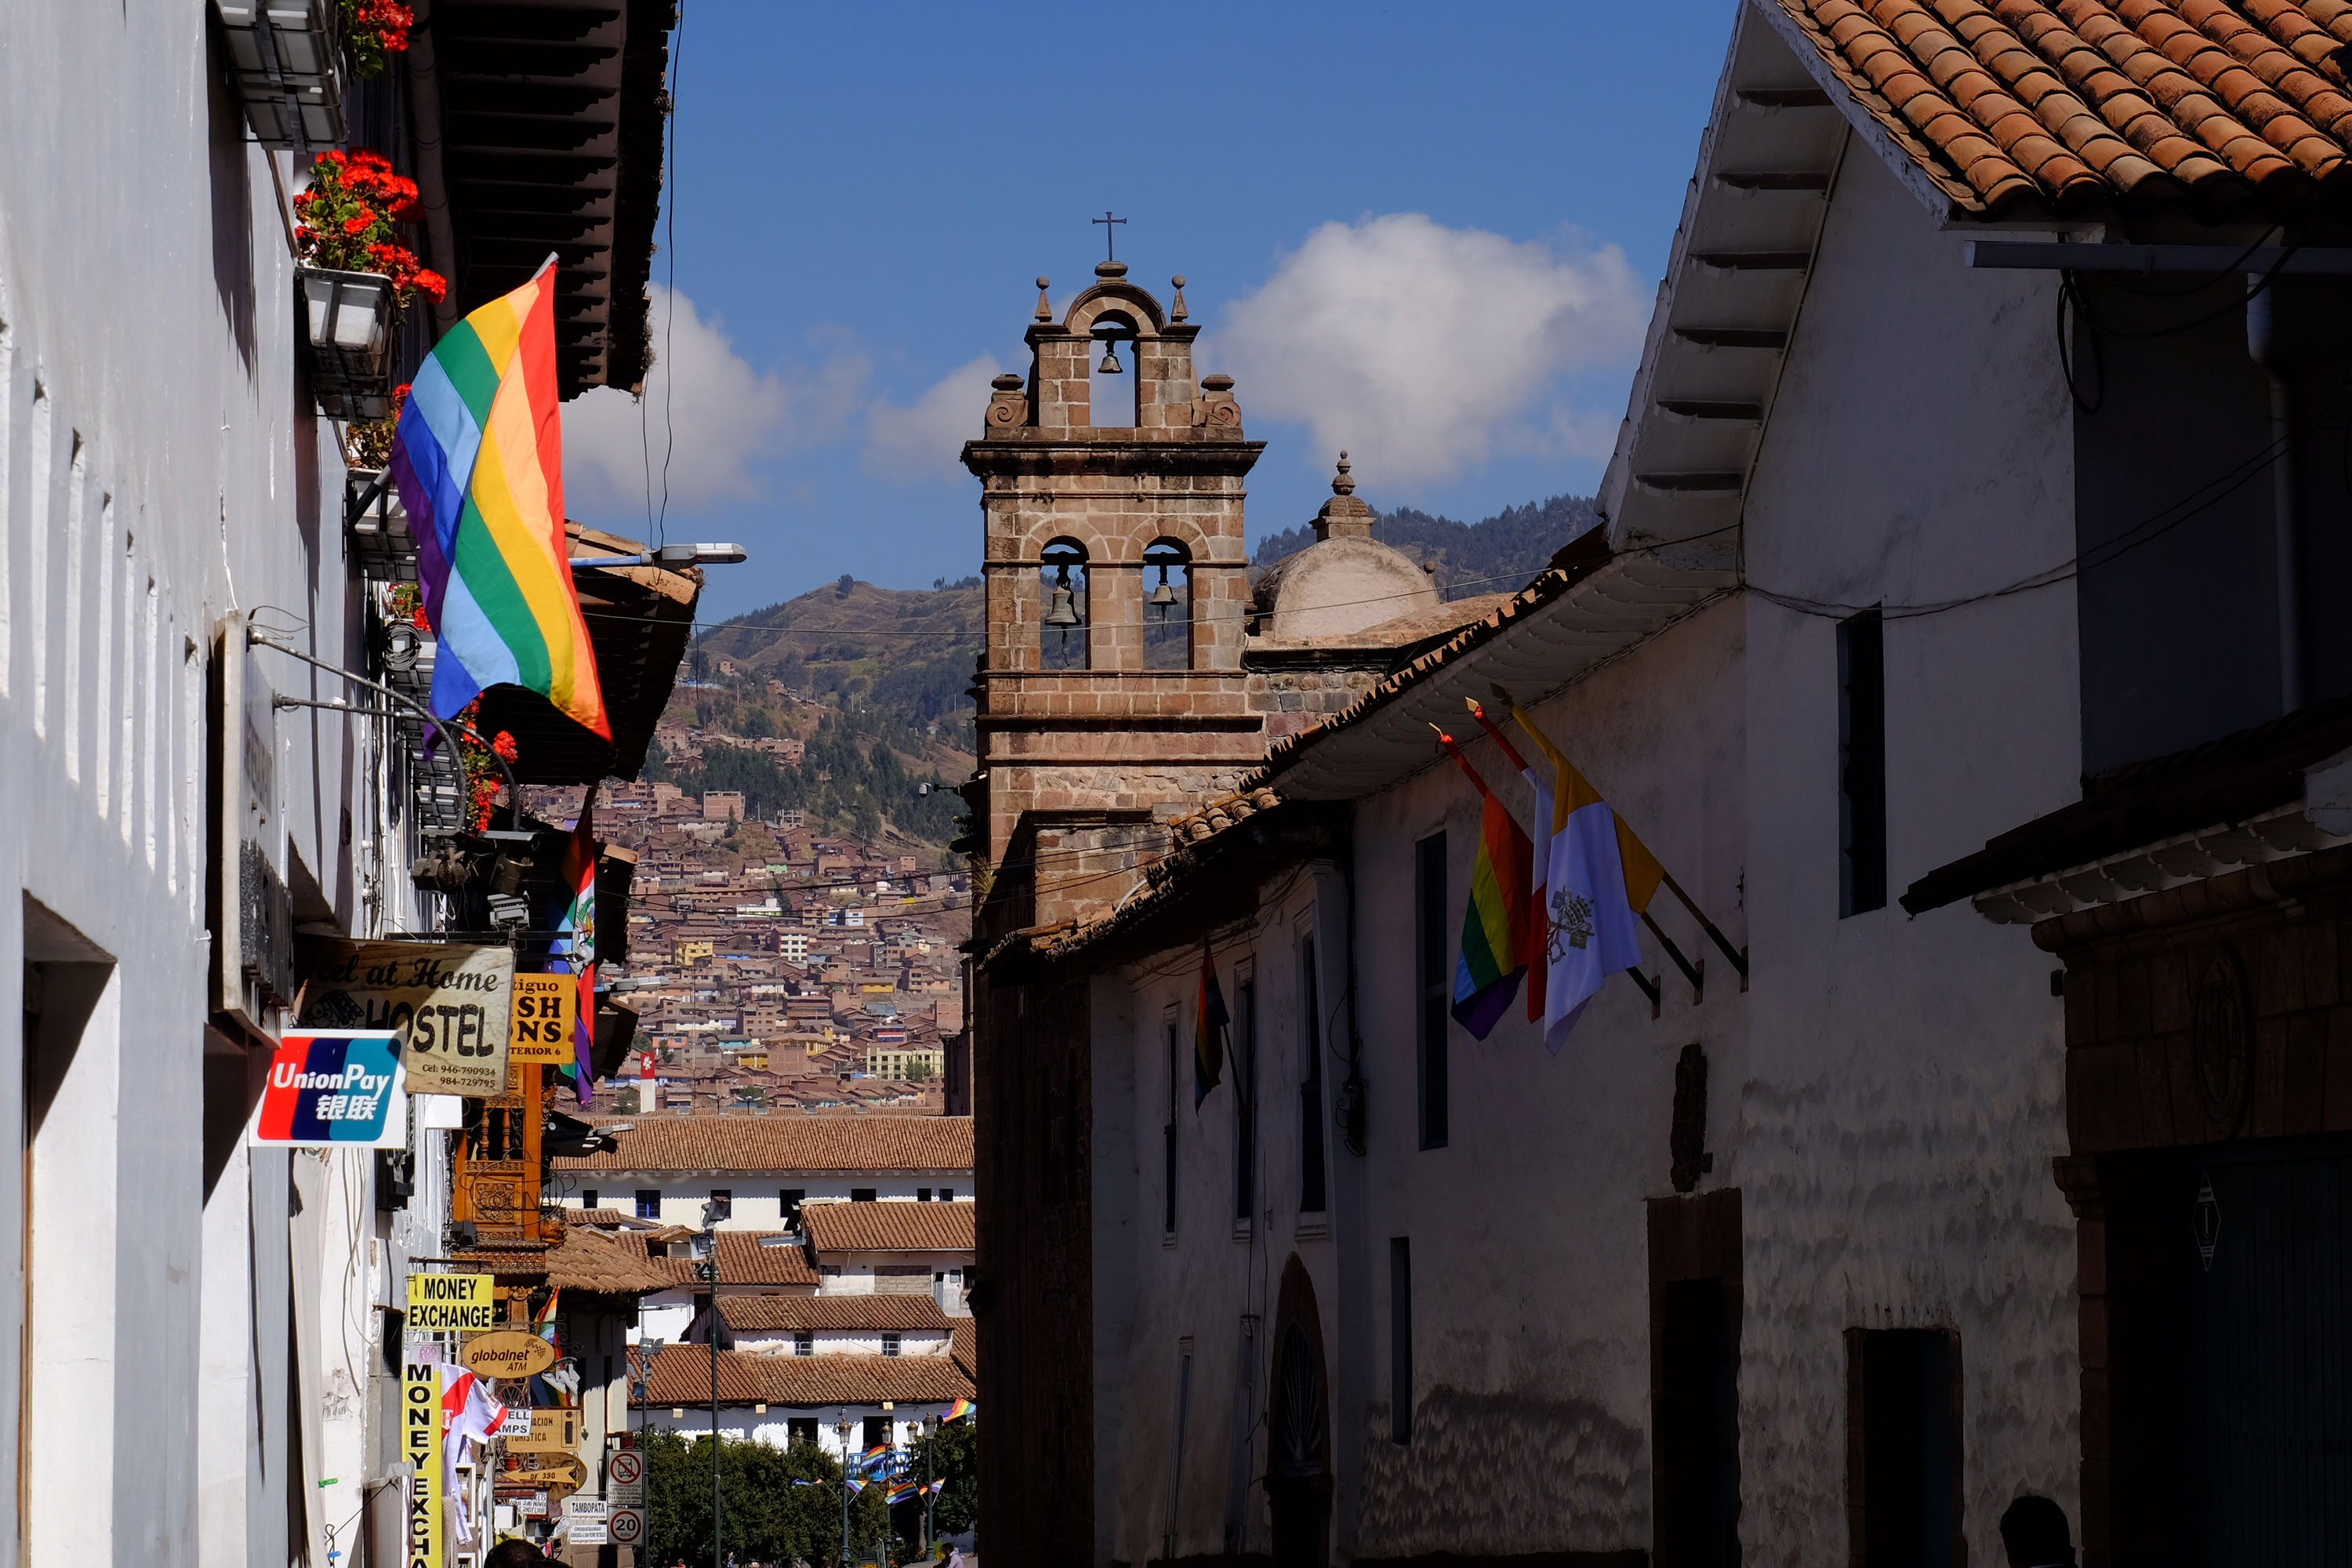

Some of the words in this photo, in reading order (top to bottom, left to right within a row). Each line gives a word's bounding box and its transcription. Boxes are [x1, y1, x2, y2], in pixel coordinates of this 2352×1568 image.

[315, 953, 359, 985] eel
[365, 960, 398, 987] at
[407, 958, 499, 993] Home
[365, 997, 495, 1058] HOSTEL
[510, 1020, 562, 1043] NS
[422, 1064, 439, 1074] Cel:
[441, 1065, 495, 1076] 946-790934
[273, 1062, 390, 1101] UnionPay
[440, 1076, 495, 1088] 984-729795
[316, 1094, 378, 1121] 银联
[424, 1277, 478, 1301] MONEY
[409, 1305, 491, 1328] EXCHANGE
[420, 1346, 437, 1356] 500
[471, 1348, 530, 1364] globalnet
[506, 1362, 528, 1371] ATM
[407, 1363, 432, 1471] MONEY
[532, 1417, 553, 1427] ACION
[542, 1472, 556, 1480] 390
[572, 1502, 605, 1514] TAMBOPATA
[615, 1519, 637, 1531] 20
